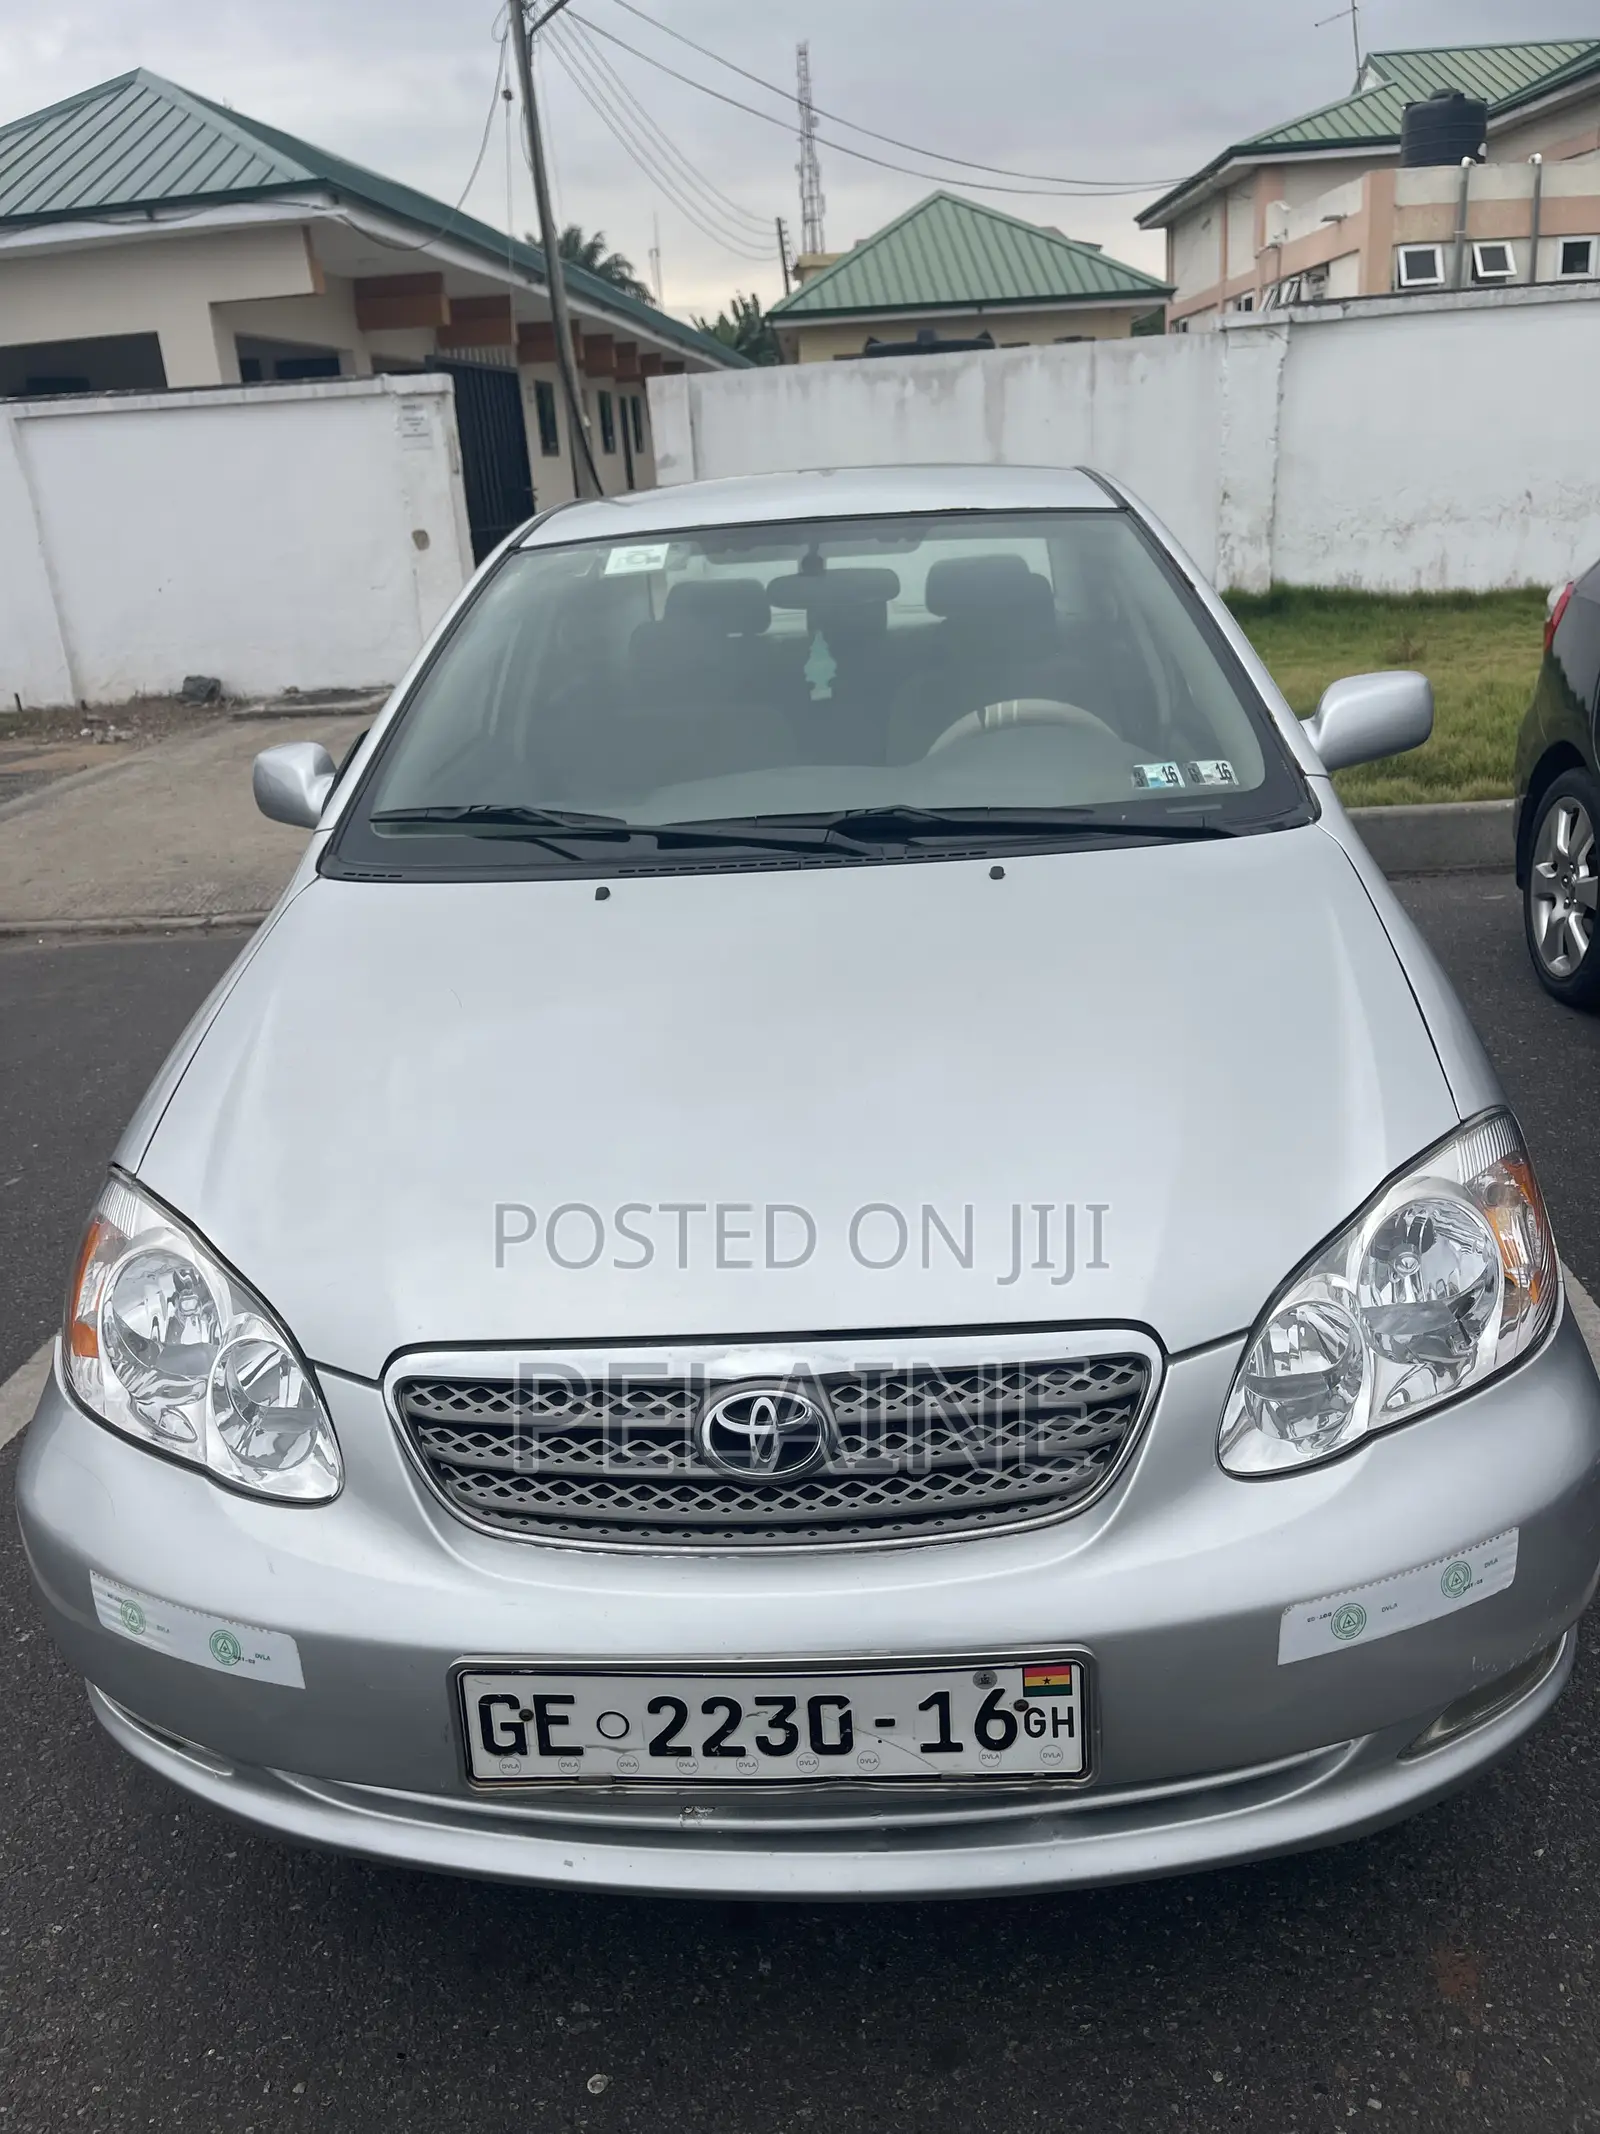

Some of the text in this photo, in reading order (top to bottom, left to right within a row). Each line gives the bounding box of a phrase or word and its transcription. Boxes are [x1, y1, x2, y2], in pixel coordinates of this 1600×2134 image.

[1161, 765, 1179, 784] 16
[1215, 762, 1232, 781] 16
[1381, 1602, 1399, 1613] DVLA
[254, 1653, 271, 1662] DVLA
[478, 1692, 584, 1757] GE
[1024, 1706, 1075, 1739] GH
